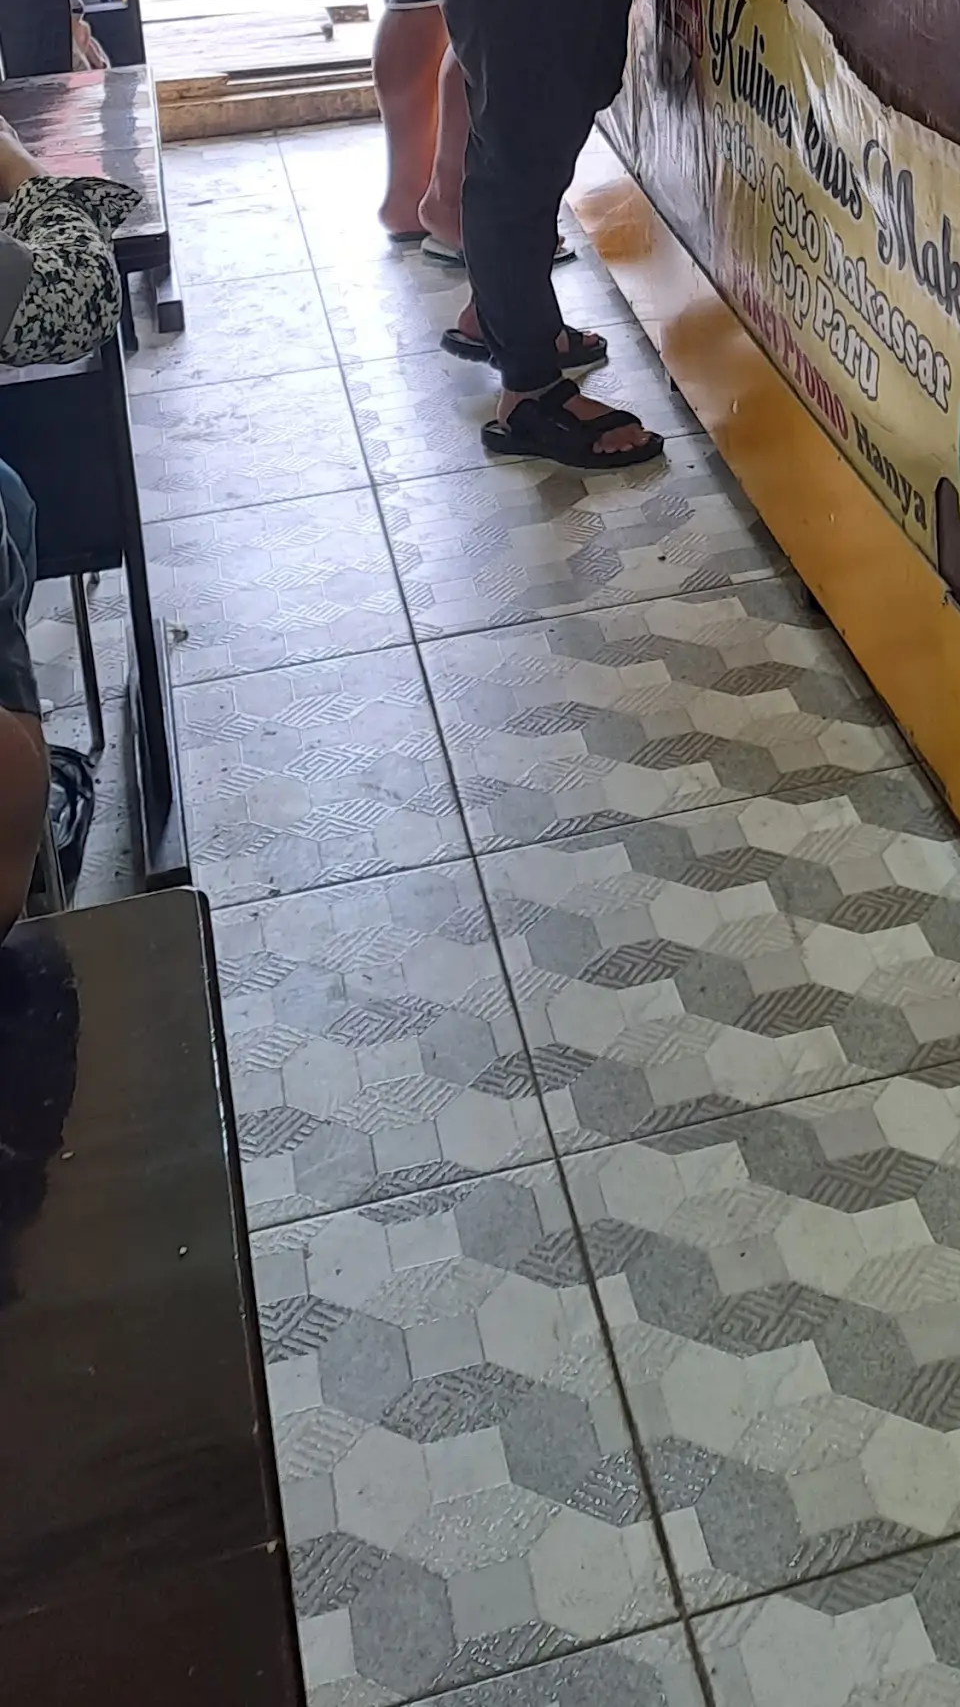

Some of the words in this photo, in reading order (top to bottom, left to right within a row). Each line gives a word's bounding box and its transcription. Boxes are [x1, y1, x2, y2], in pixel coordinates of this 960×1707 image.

[770, 226, 810, 330] Sop
[813, 275, 879, 401] Paru
[771, 163, 820, 262] Coto
[824, 216, 951, 413] Makassar
[778, 312, 848, 440] Promo
[852, 413, 926, 529] Hanya
